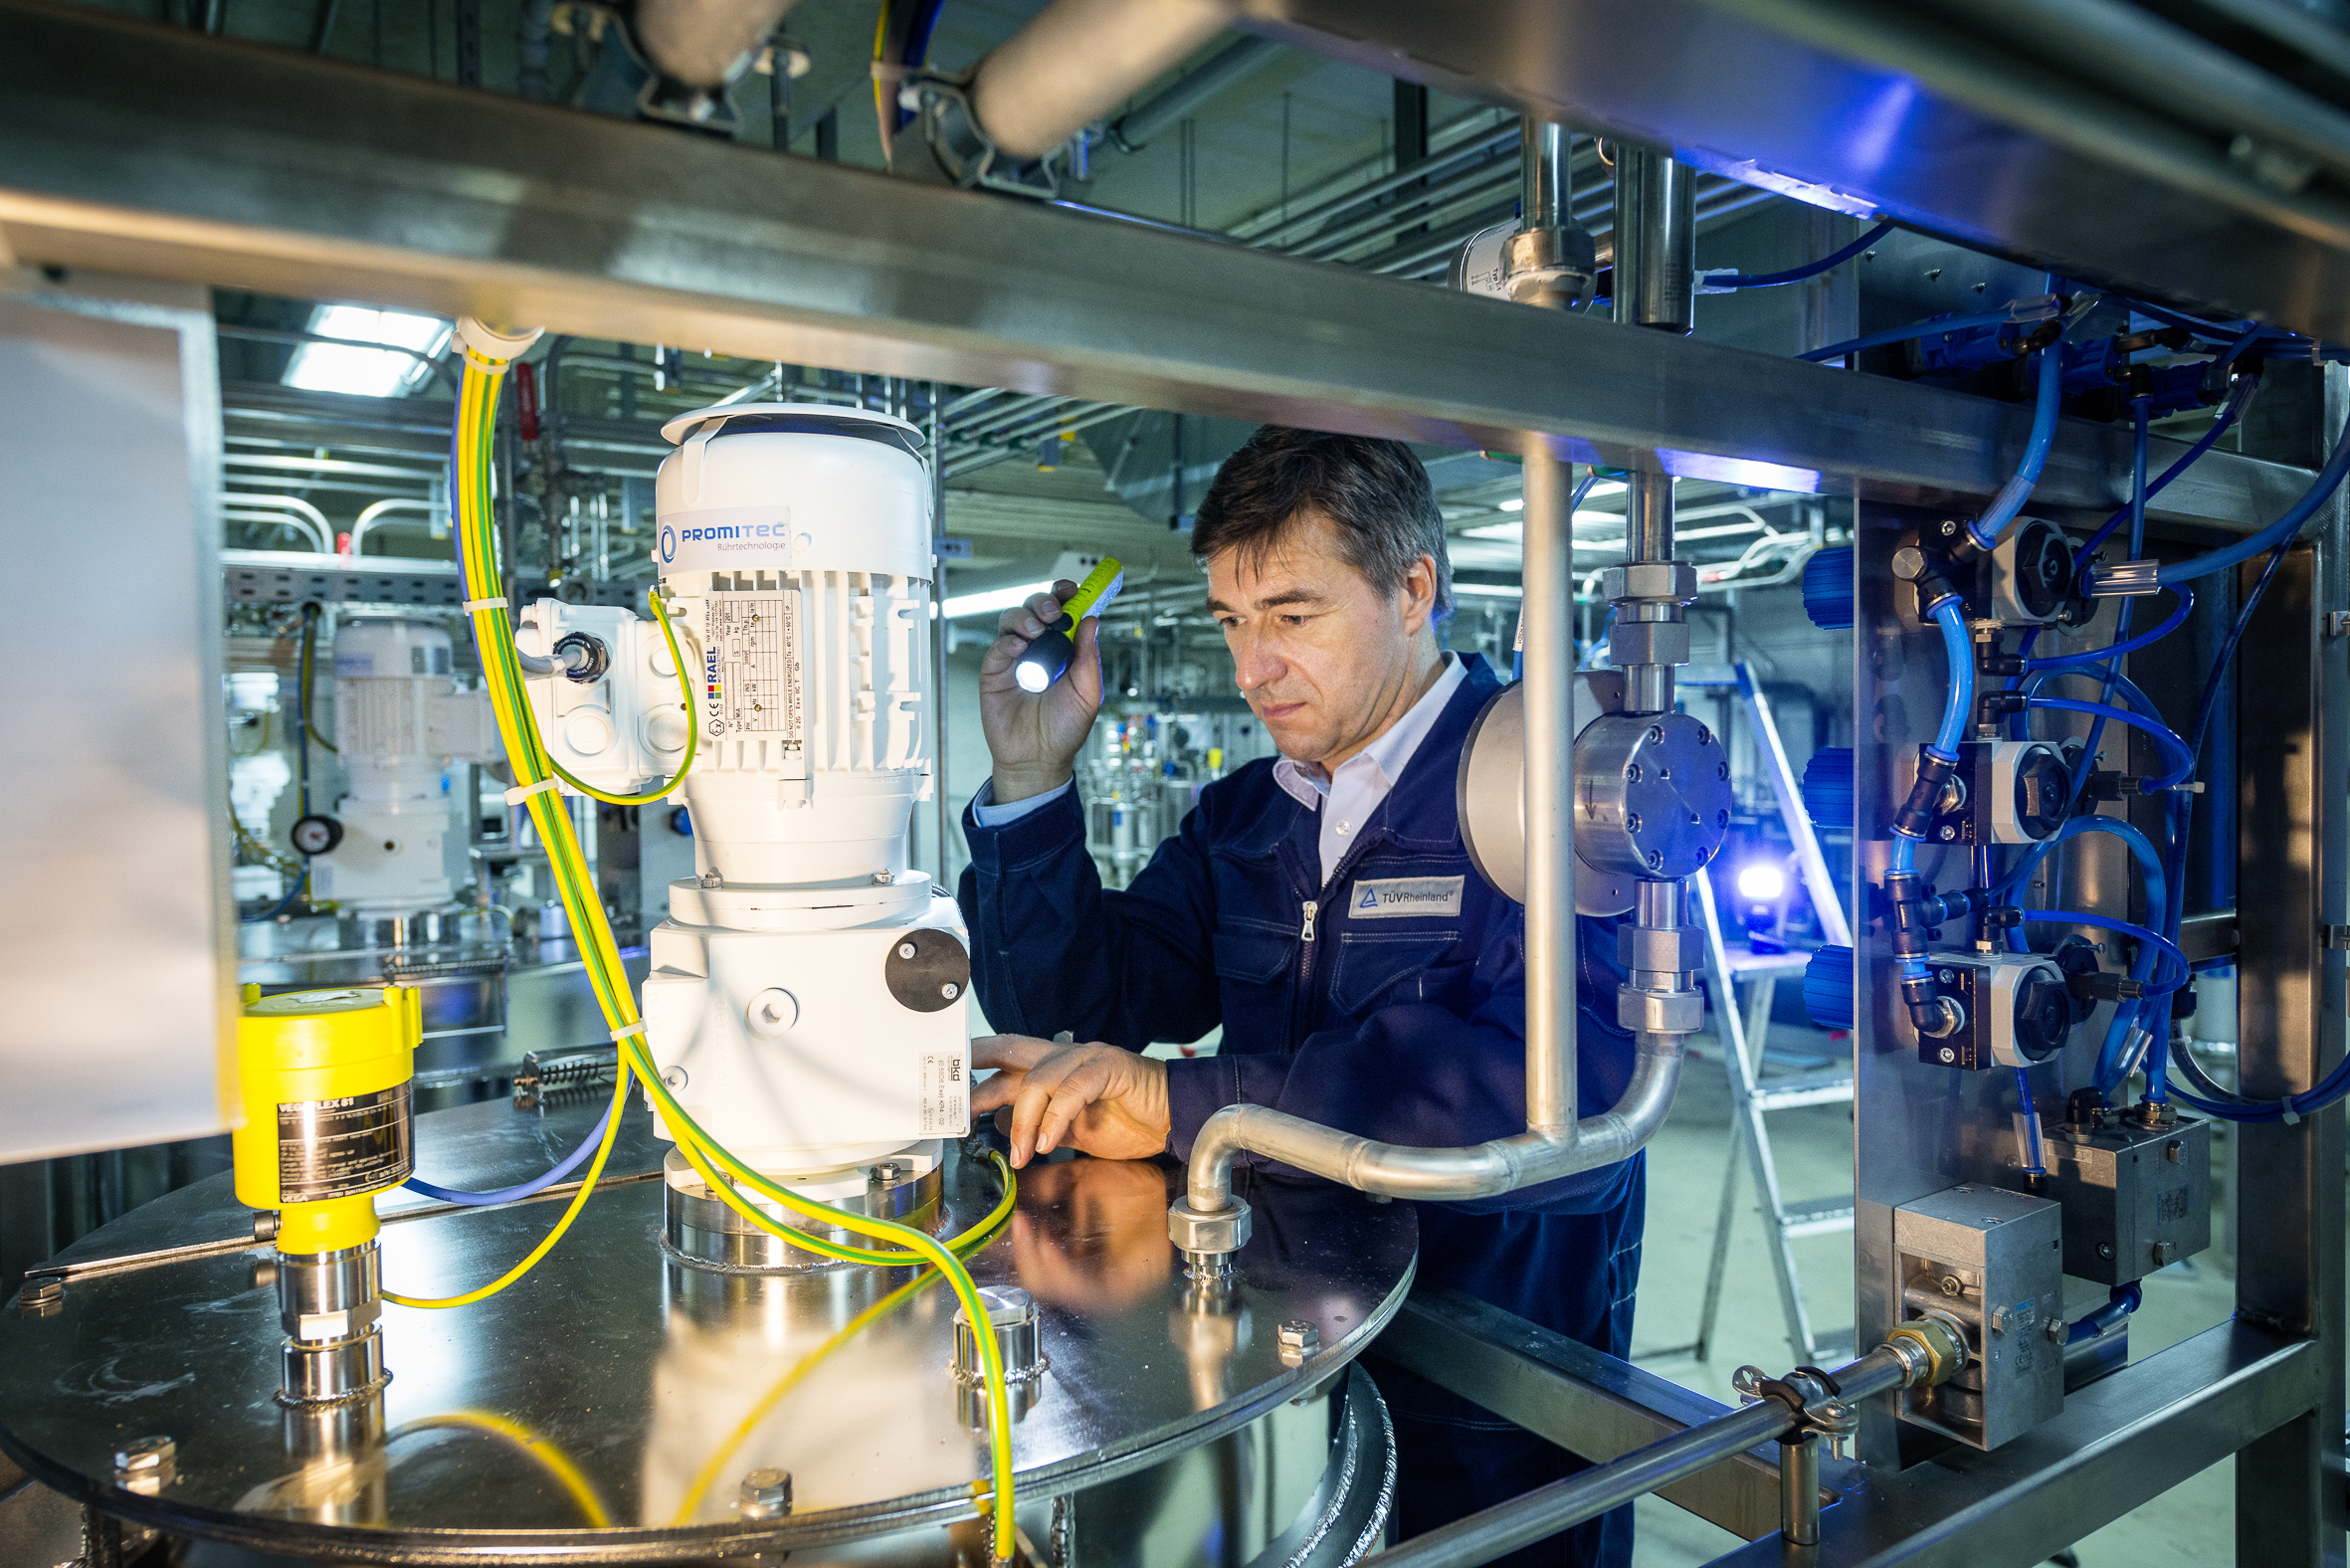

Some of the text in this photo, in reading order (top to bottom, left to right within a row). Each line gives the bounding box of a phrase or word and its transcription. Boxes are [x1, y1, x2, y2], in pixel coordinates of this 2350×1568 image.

[717, 541, 786, 551] Rührtechnologie
[706, 647, 716, 683] RAEL
[279, 1099, 340, 1112] VEGLEX
